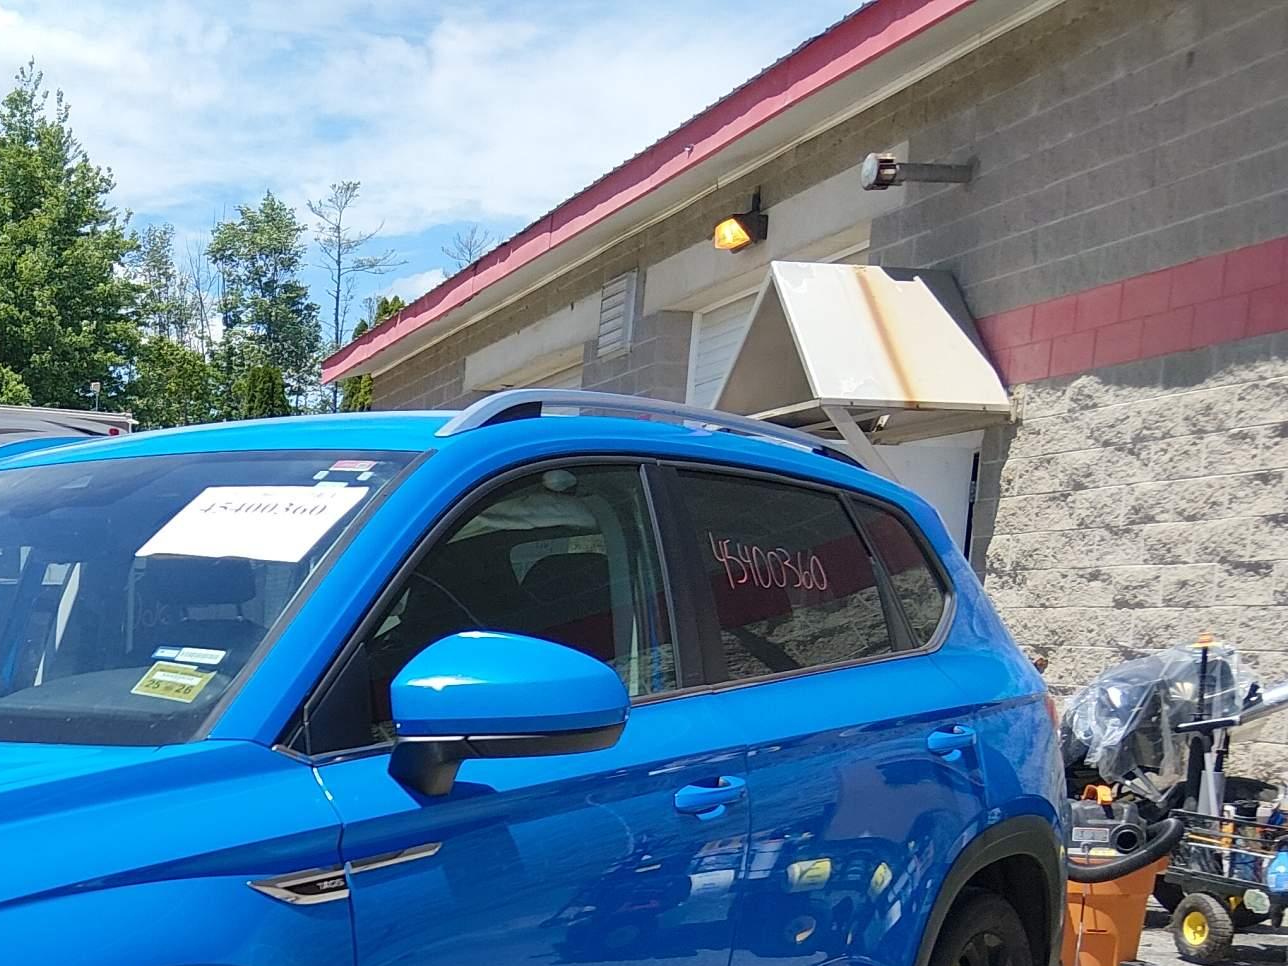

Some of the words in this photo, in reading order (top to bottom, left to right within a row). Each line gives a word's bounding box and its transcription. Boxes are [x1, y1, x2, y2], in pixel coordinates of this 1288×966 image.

[708, 531, 827, 590] 45400360
[144, 679, 161, 690] 25
[174, 684, 192, 695] 26
